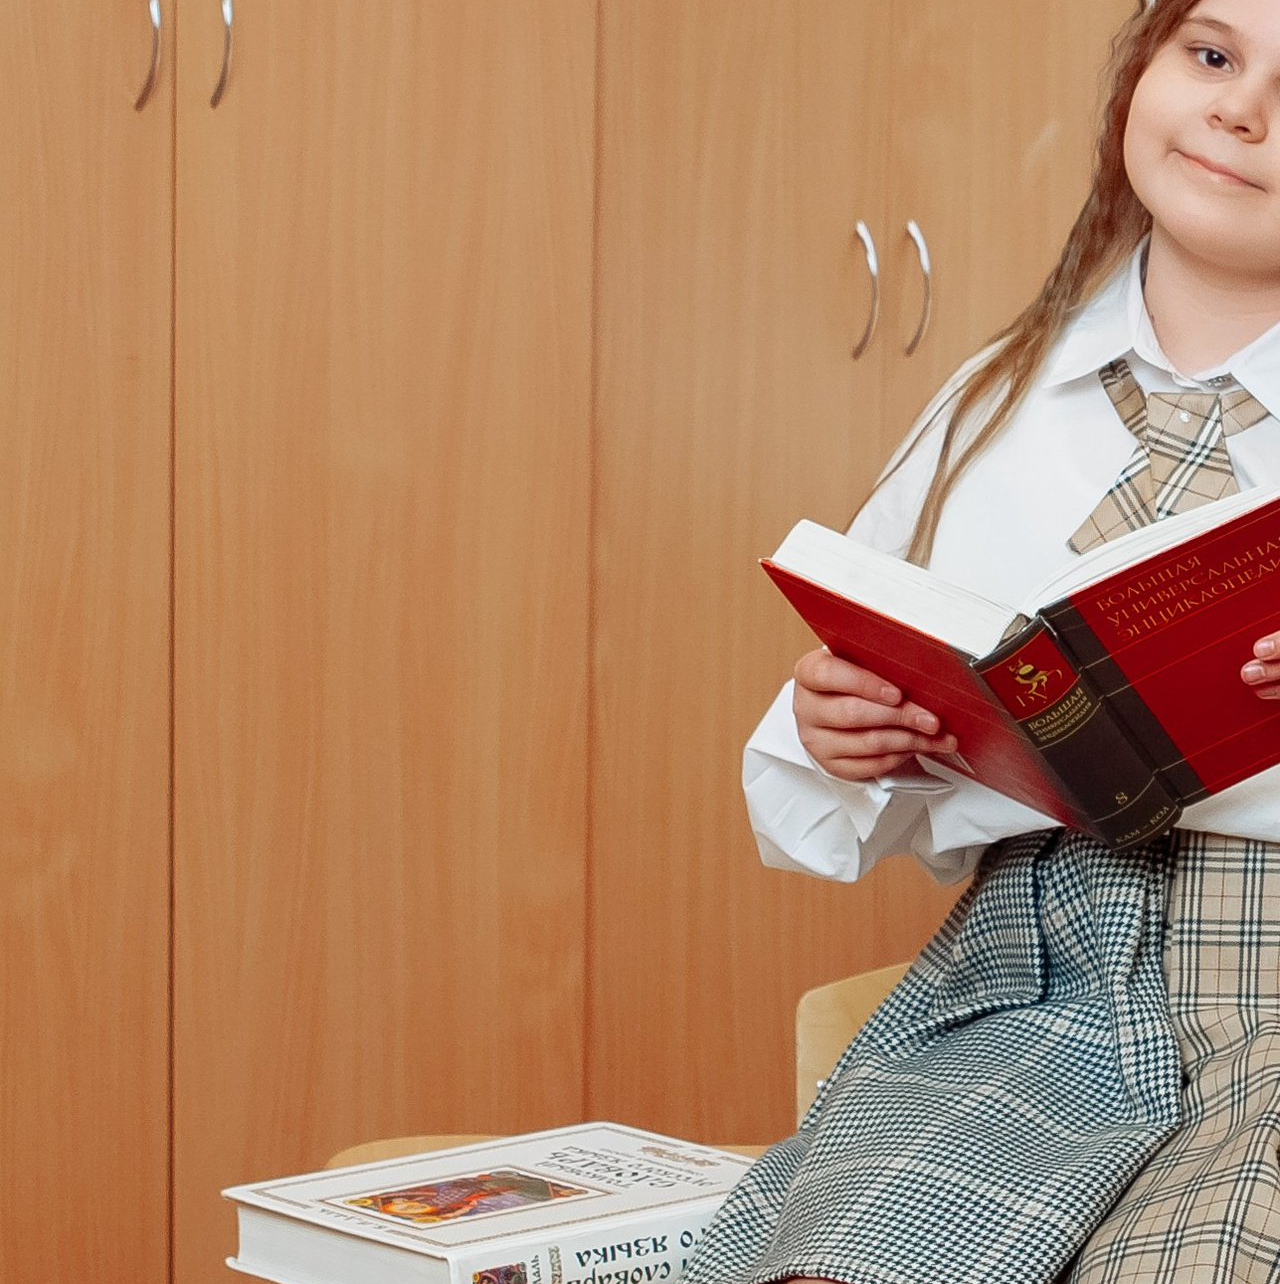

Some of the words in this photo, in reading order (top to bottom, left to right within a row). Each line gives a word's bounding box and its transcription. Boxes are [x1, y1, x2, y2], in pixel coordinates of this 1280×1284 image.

[1096, 556, 1202, 612] БОЛЬШАЯ
[1028, 687, 1084, 731] БОЛЬШАЯ
[1115, 792, 1128, 805] 8
[1115, 829, 1141, 844] КАМ
[1149, 806, 1169, 825] КОЛ
[575, 1235, 668, 1268] языка
